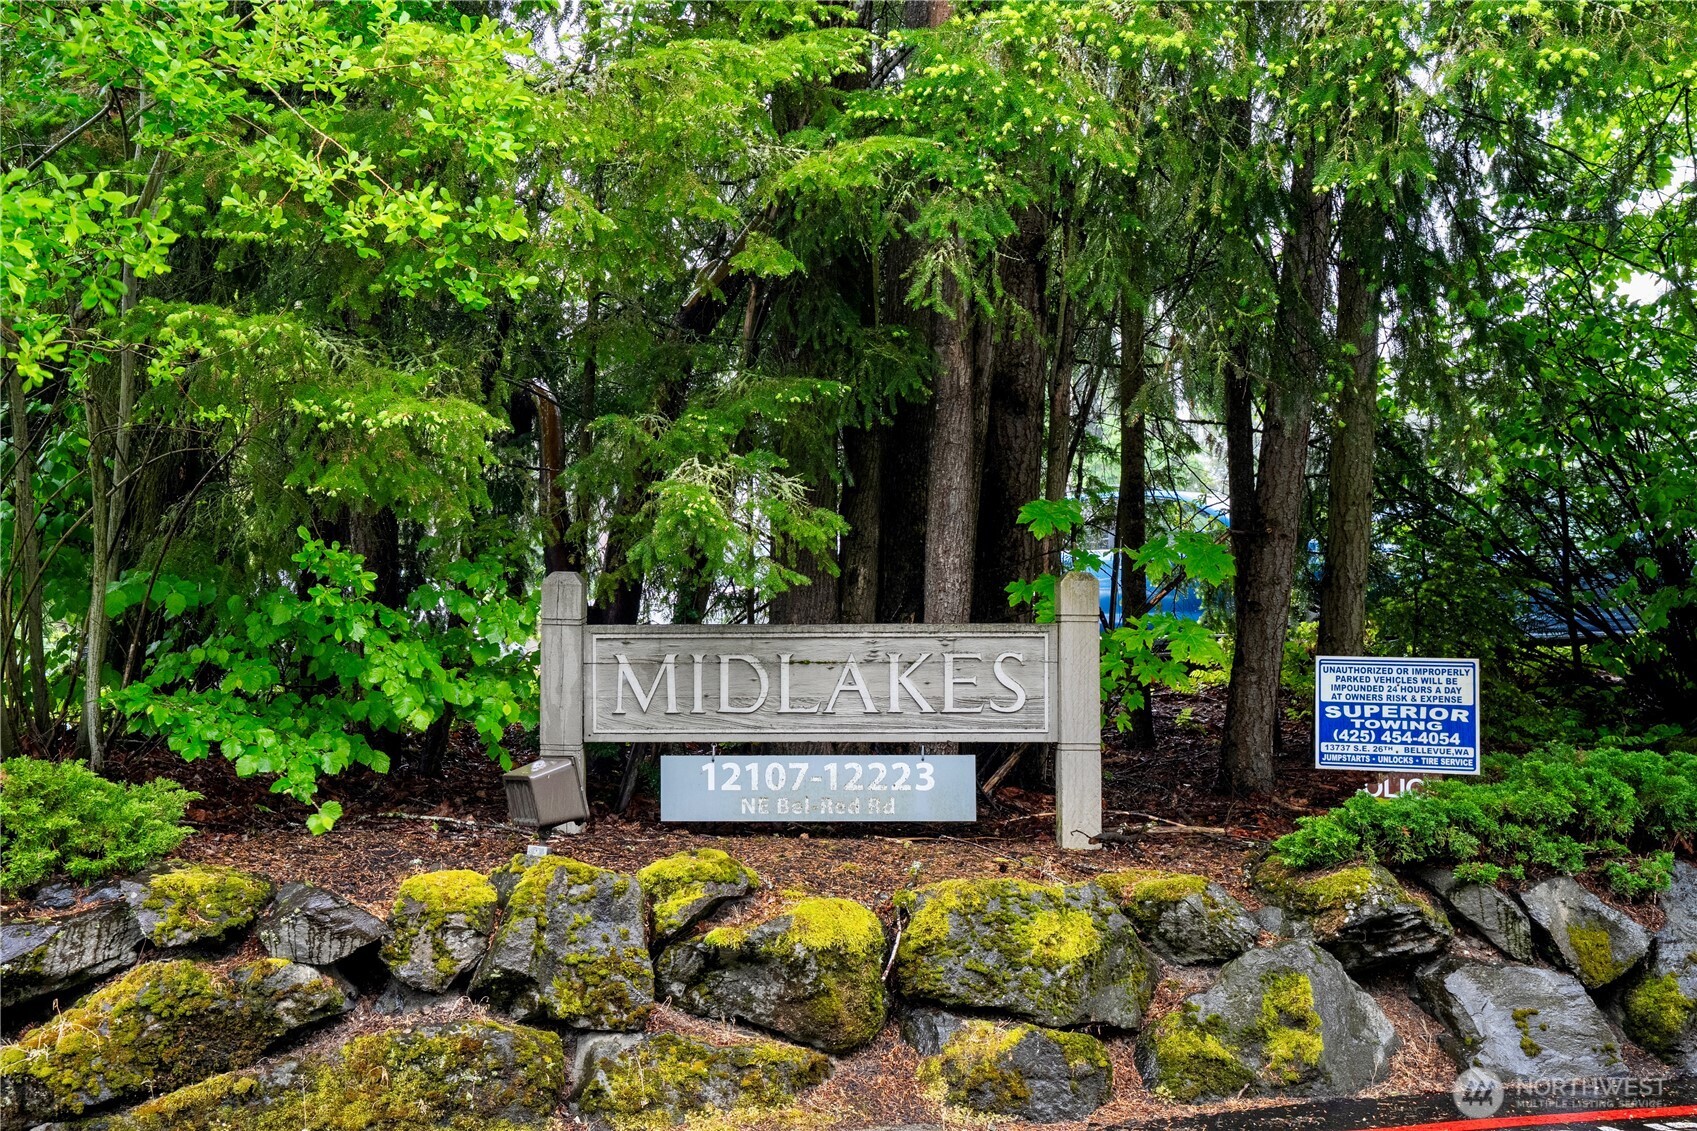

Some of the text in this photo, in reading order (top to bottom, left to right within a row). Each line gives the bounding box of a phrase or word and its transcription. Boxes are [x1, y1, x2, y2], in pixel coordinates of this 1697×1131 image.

[1322, 666, 1471, 677] UNAUTHORIZED OR IMPROPERLY
[611, 652, 1027, 715] MIDLAKES
[1335, 675, 1458, 685] PARKED VEHICLES WILL BE
[1330, 684, 1462, 694] IMPOUNDED 24 HOURS A DAY
[1331, 693, 1463, 704] AT OWNERS RISK & EXPENSE
[1325, 705, 1469, 723] SUPERIOR
[1350, 719, 1443, 731] TOWING
[1333, 729, 1461, 745] (425) 454-4054
[1321, 754, 1474, 767] JUMPSTARTS UNLOCKS TIRE SERVICE
[701, 763, 935, 791] 12107-12223
[741, 797, 769, 815] NE
[868, 797, 896, 815] Rd
